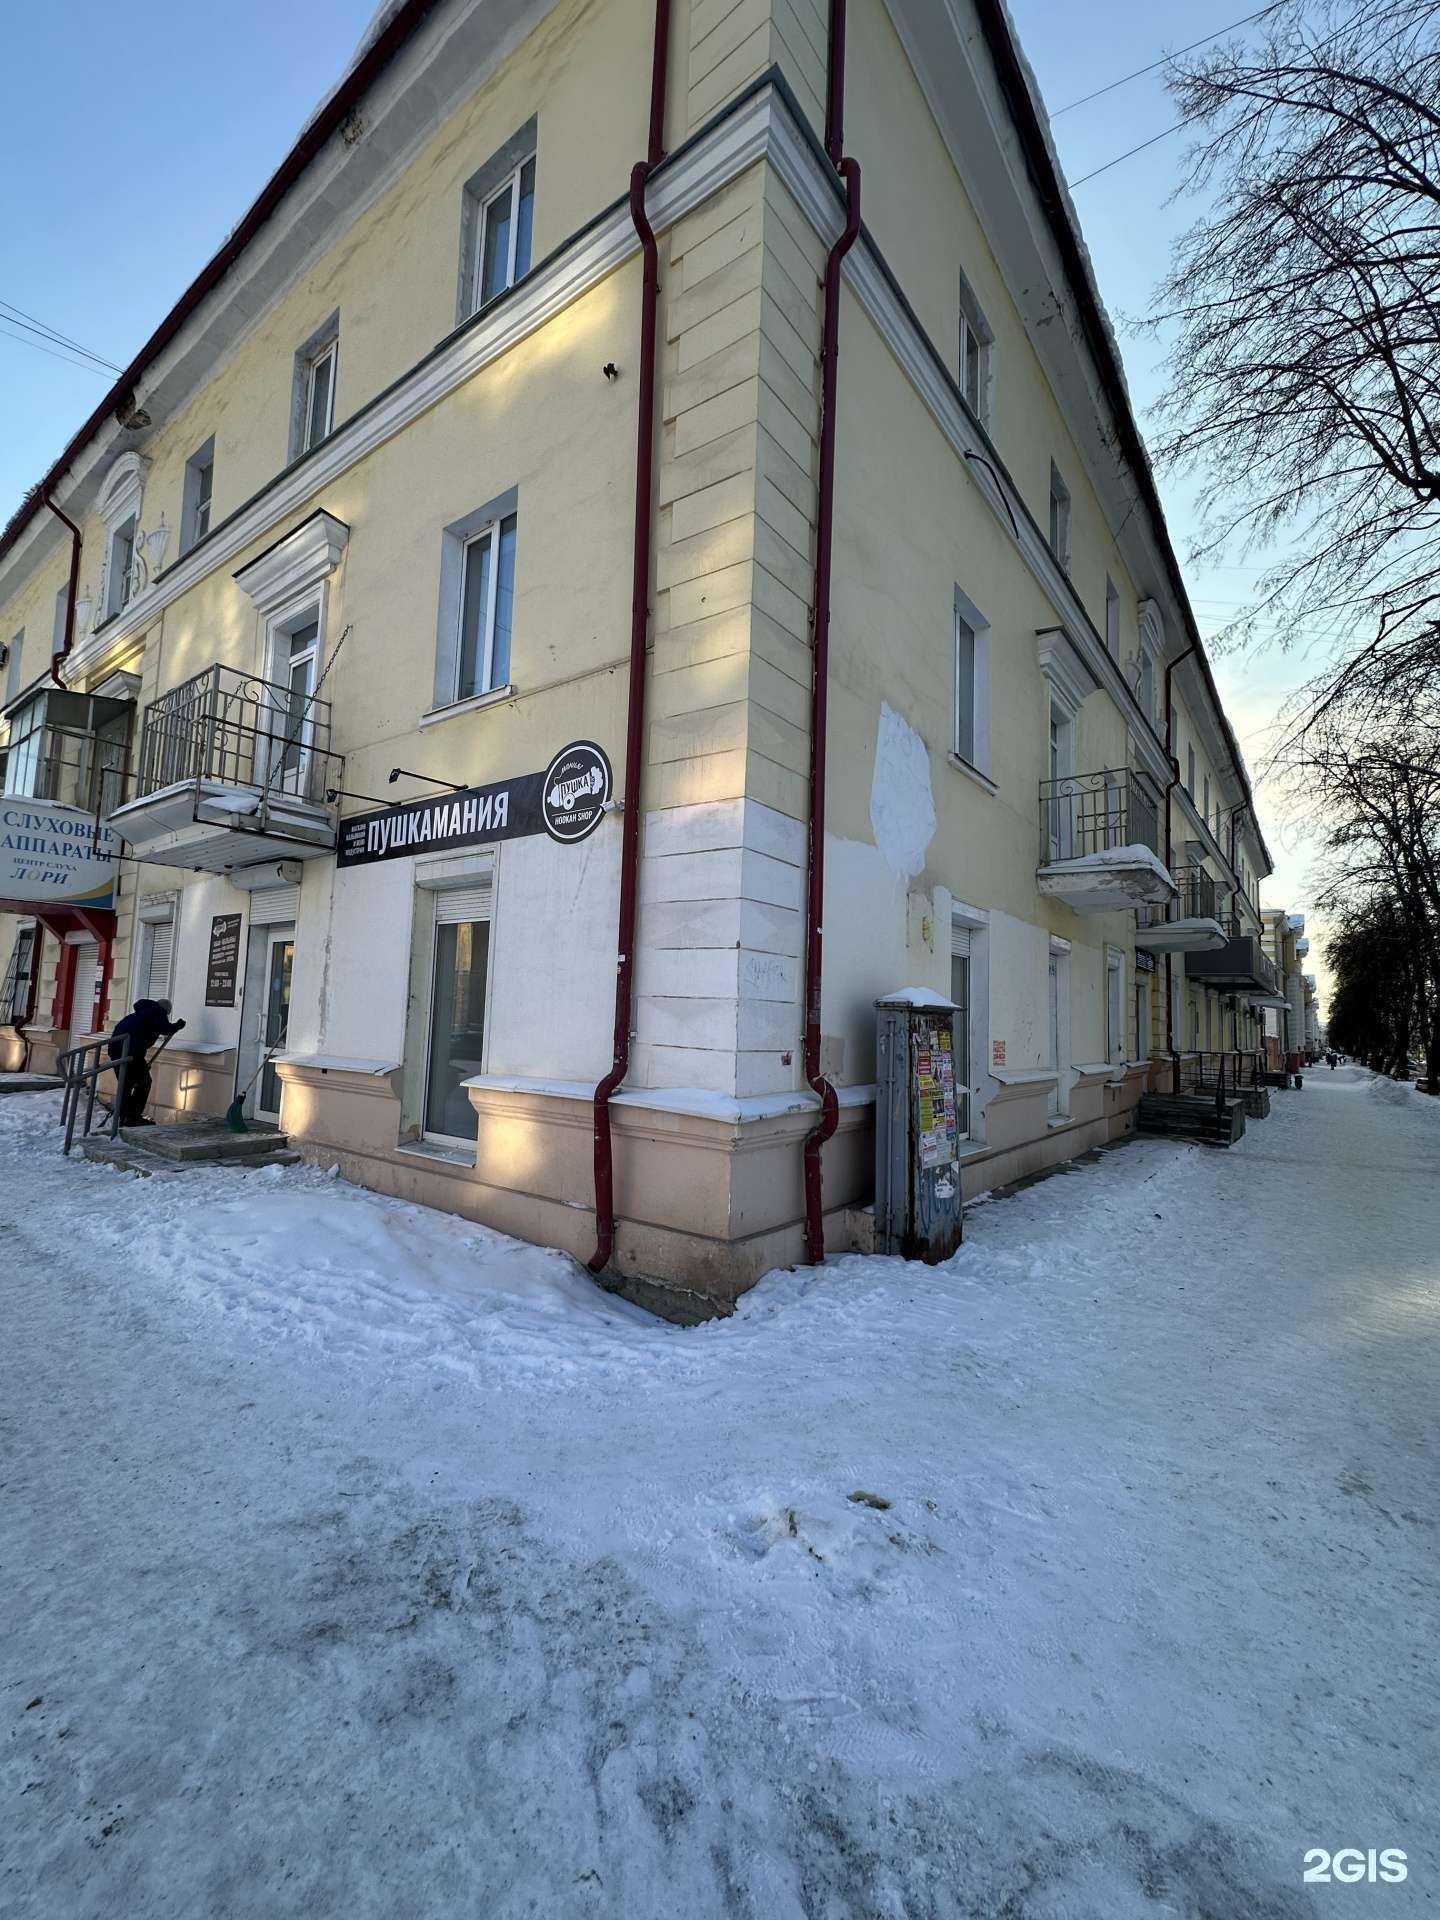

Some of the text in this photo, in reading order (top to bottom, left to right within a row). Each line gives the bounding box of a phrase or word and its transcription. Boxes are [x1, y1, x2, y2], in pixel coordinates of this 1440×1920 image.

[367, 791, 509, 856] ПУШКАМАНИЯ
[554, 810, 593, 825] HOOKAH SHOP
[1, 833, 112, 863] АППАРАТЫ
[14, 857, 79, 872] ЦЕНТР СЛУХА
[10, 867, 69, 884] ЛОРИ
